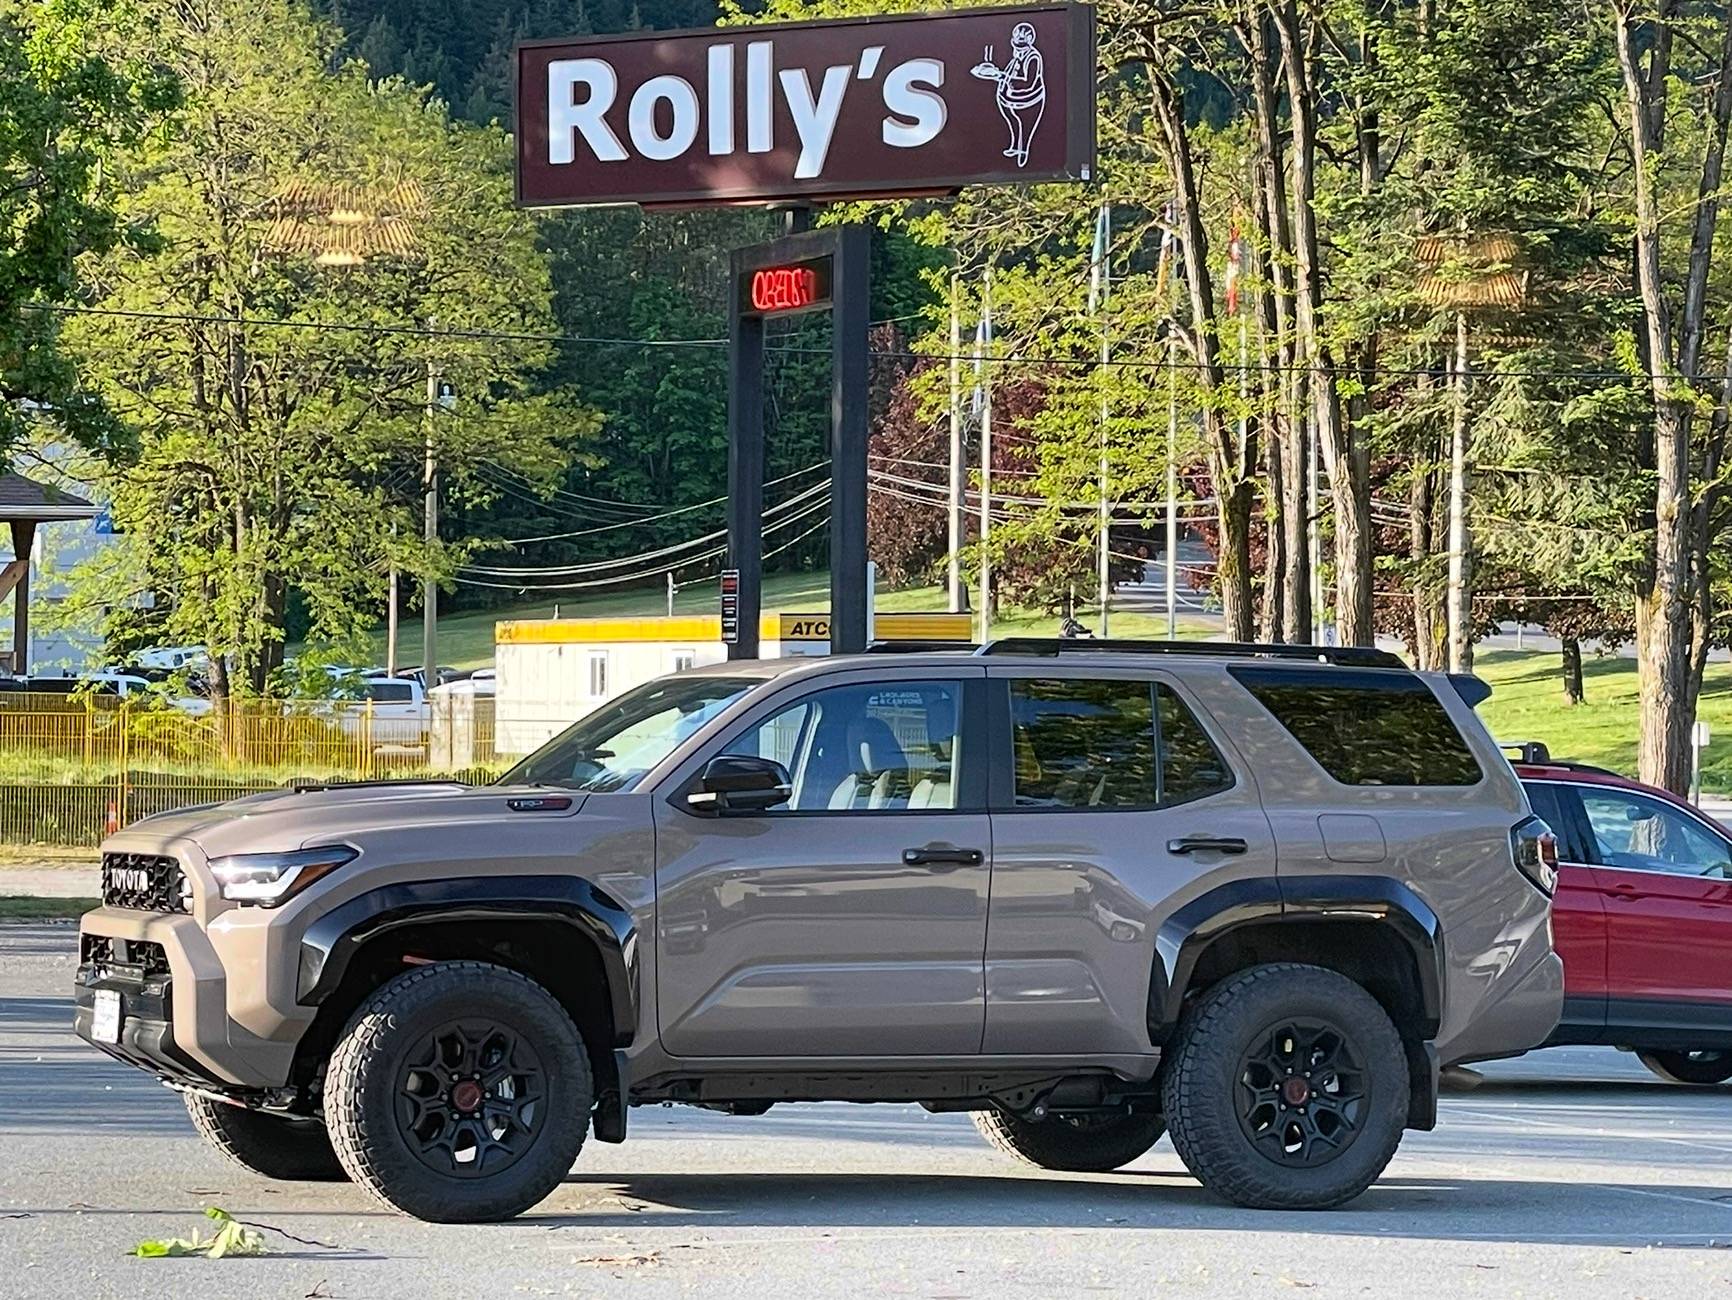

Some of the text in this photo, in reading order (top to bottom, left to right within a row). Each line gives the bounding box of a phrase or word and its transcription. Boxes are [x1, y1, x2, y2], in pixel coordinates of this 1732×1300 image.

[548, 40, 948, 180] Rolly's
[790, 621, 832, 636] ATC
[111, 868, 148, 892] TOYOTA
